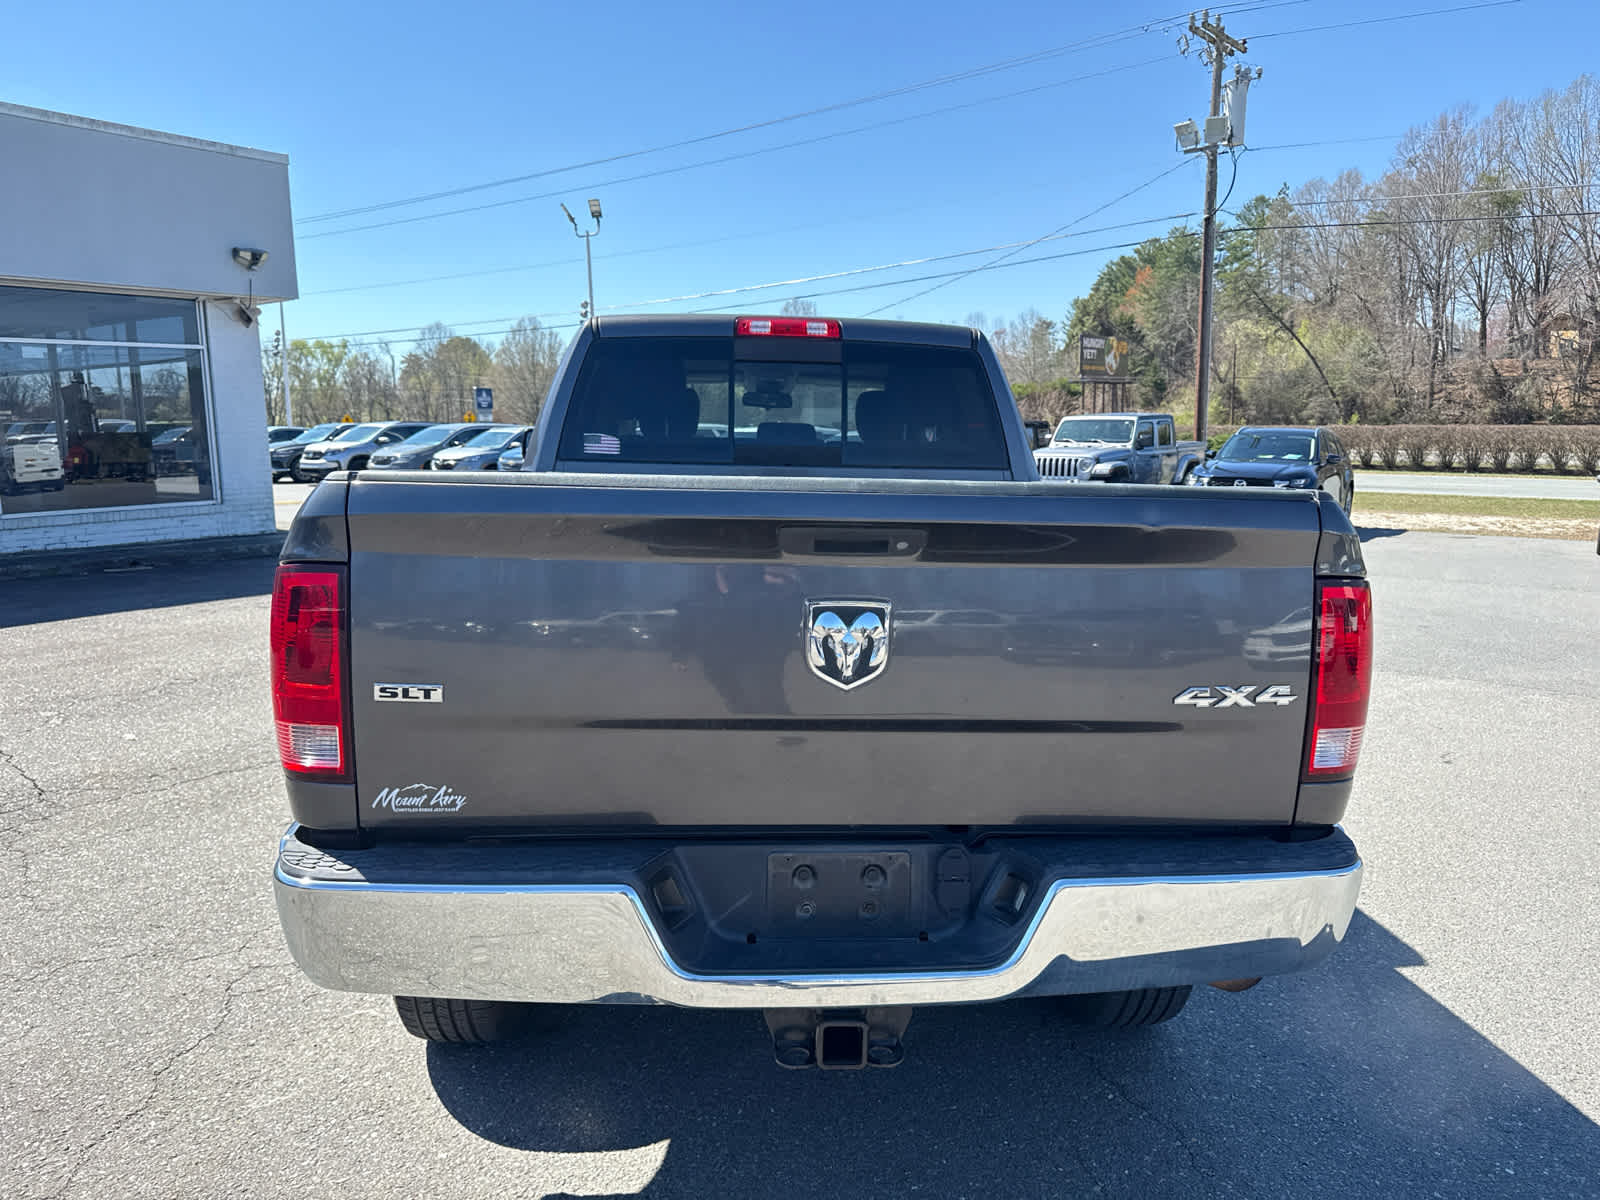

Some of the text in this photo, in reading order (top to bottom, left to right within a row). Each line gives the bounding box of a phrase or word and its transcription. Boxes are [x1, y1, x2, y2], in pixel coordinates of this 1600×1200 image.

[378, 685, 438, 700] SLT
[371, 784, 467, 812] Mount Airy
